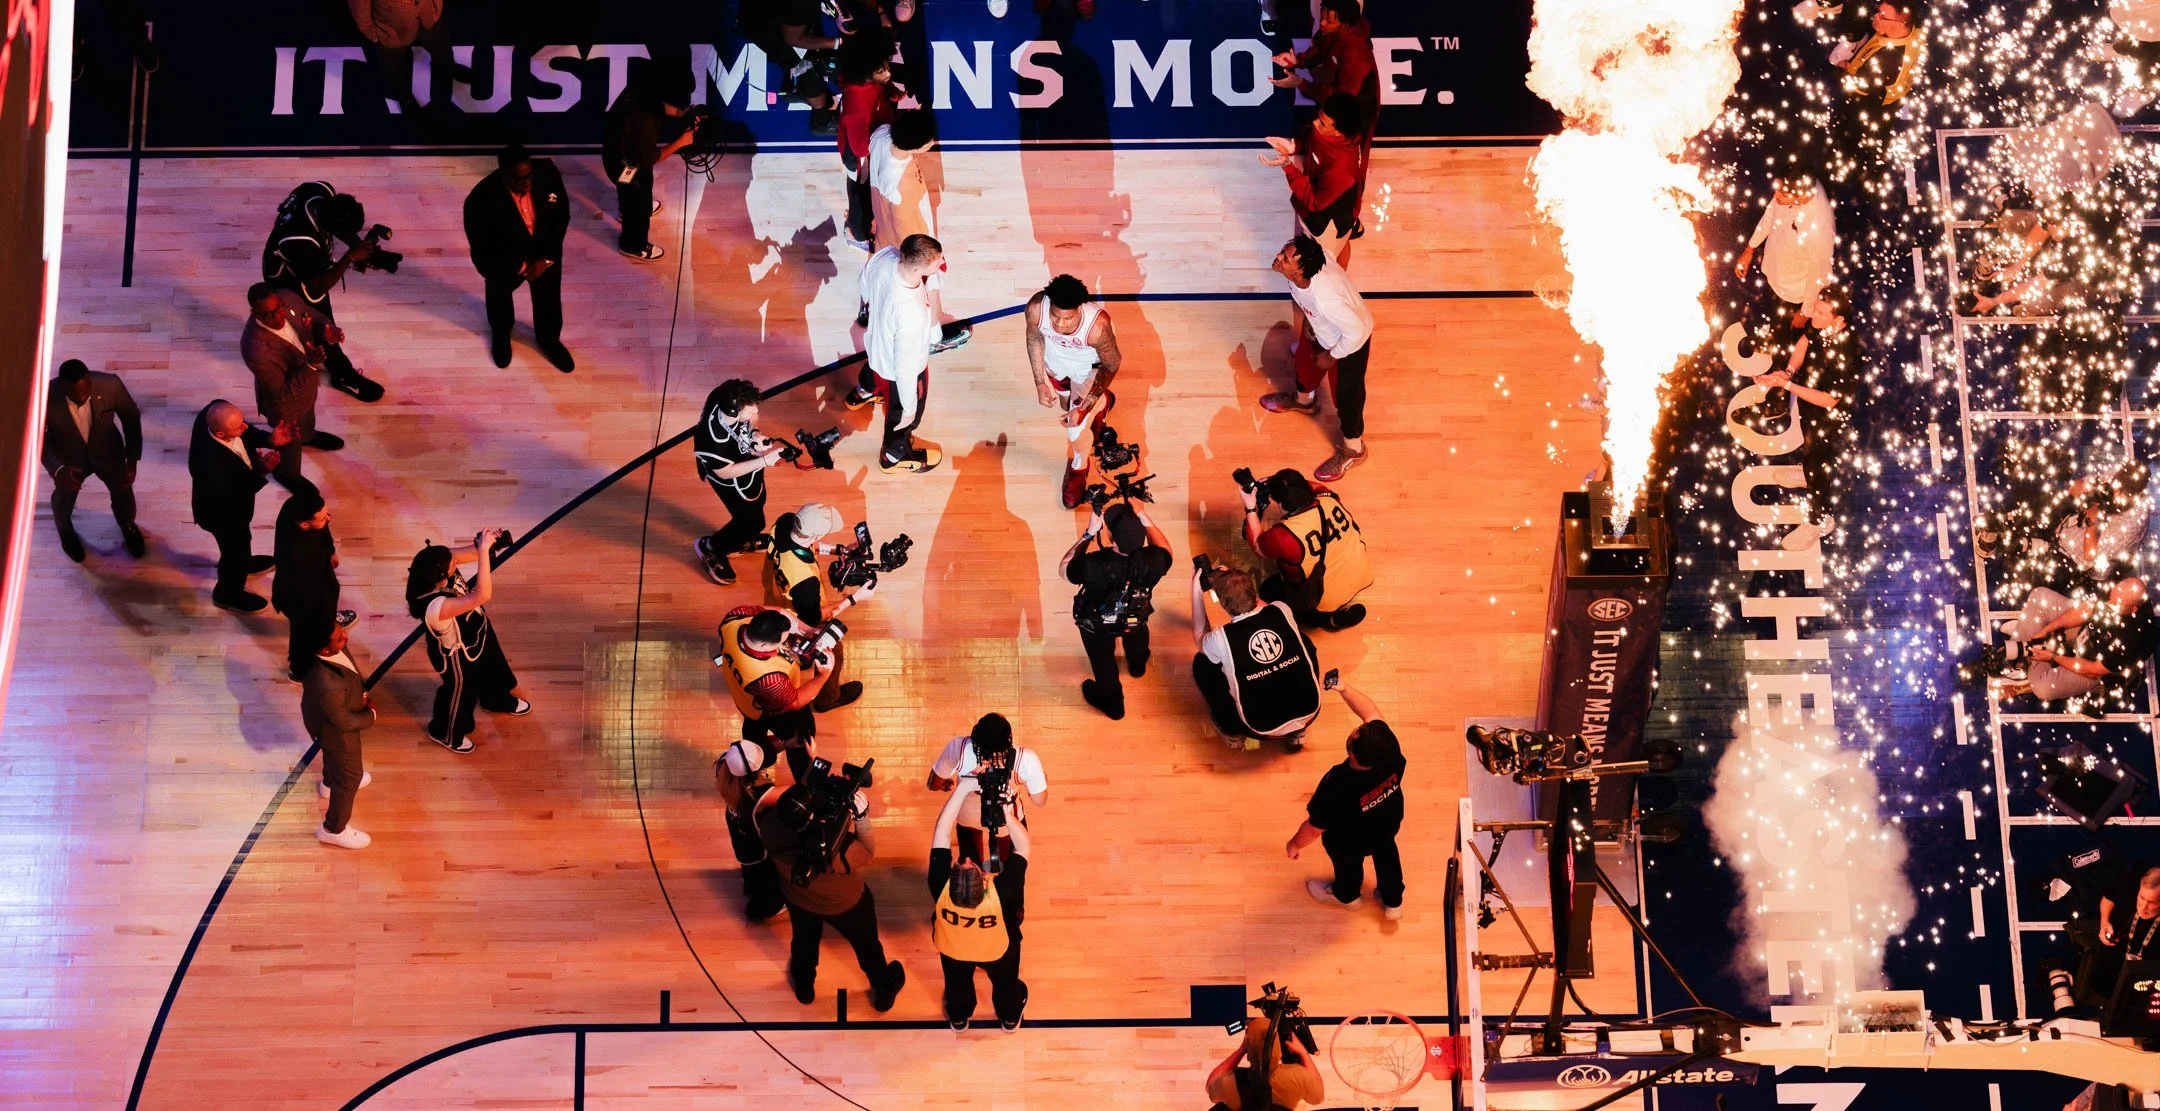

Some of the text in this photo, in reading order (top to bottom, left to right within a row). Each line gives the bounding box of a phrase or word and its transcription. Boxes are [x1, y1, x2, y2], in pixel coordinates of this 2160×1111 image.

[271, 47, 366, 115] IT
[385, 44, 651, 113] JUST
[689, 39, 1064, 112] MNS
[1113, 37, 1455, 109] MOE.
[1305, 505, 1350, 557] 049
[1590, 599, 1630, 620] SEC
[1250, 630, 1282, 662] SEC
[1593, 630, 1620, 647] IT
[1246, 668, 1273, 681] DIGITAL
[1279, 655, 1300, 669] SOCIAL
[1587, 649, 1617, 693] JUST
[1361, 784, 1399, 812] SOCIAL
[941, 908, 997, 928] 078
